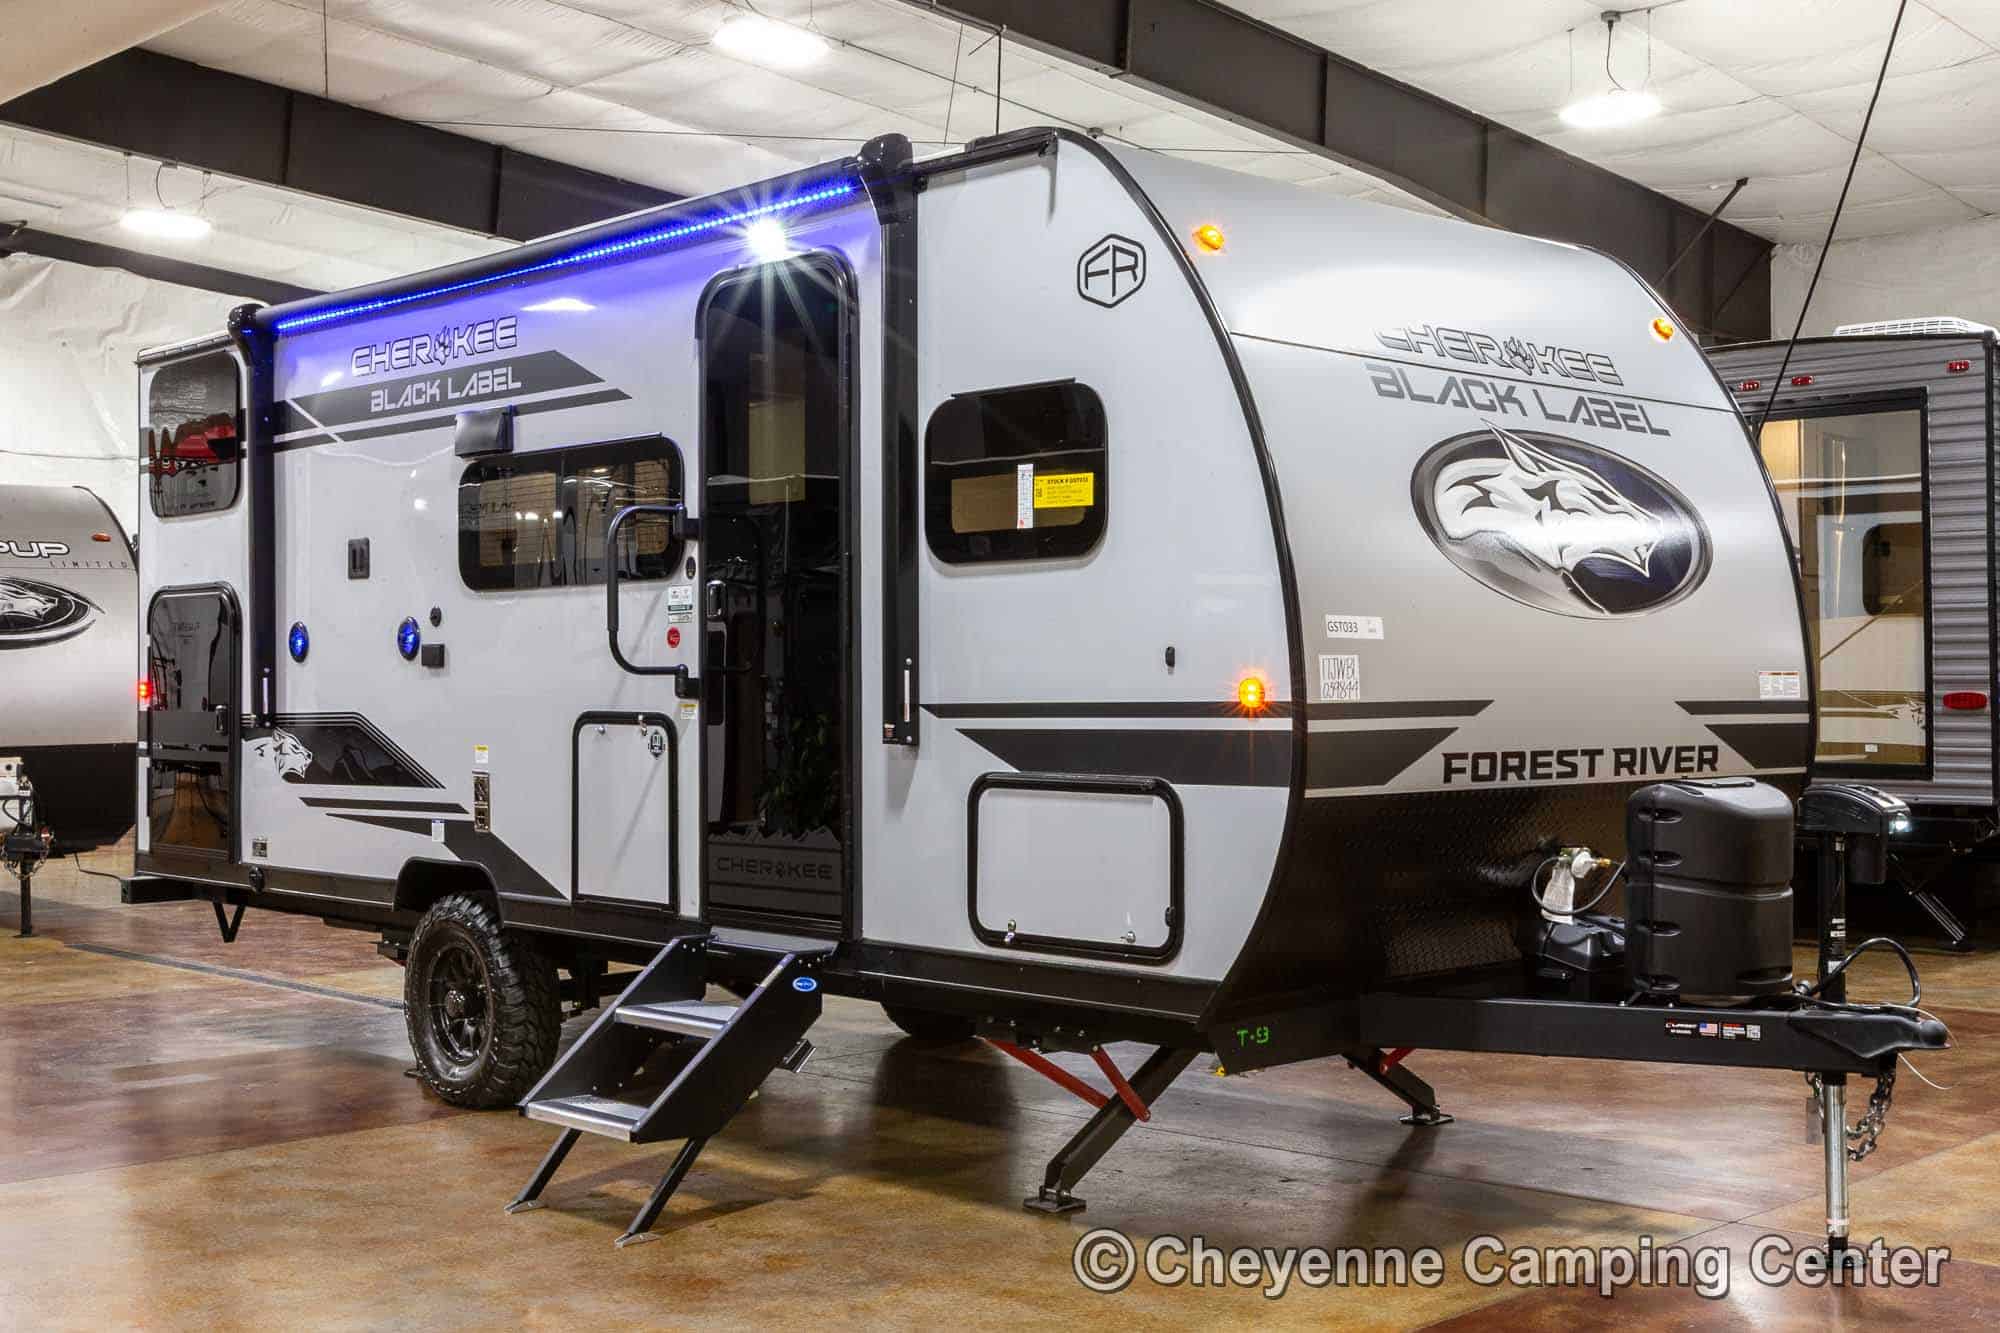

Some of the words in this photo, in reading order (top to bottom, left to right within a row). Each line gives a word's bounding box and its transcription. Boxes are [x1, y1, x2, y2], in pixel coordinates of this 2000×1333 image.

[370, 379, 441, 413] BLACK
[447, 366, 522, 400] LABEL
[1364, 362, 1528, 417] BLACK
[1532, 388, 1672, 437] LABEL
[1441, 749, 1604, 784] FOREST
[1612, 745, 1719, 777] RIVER
